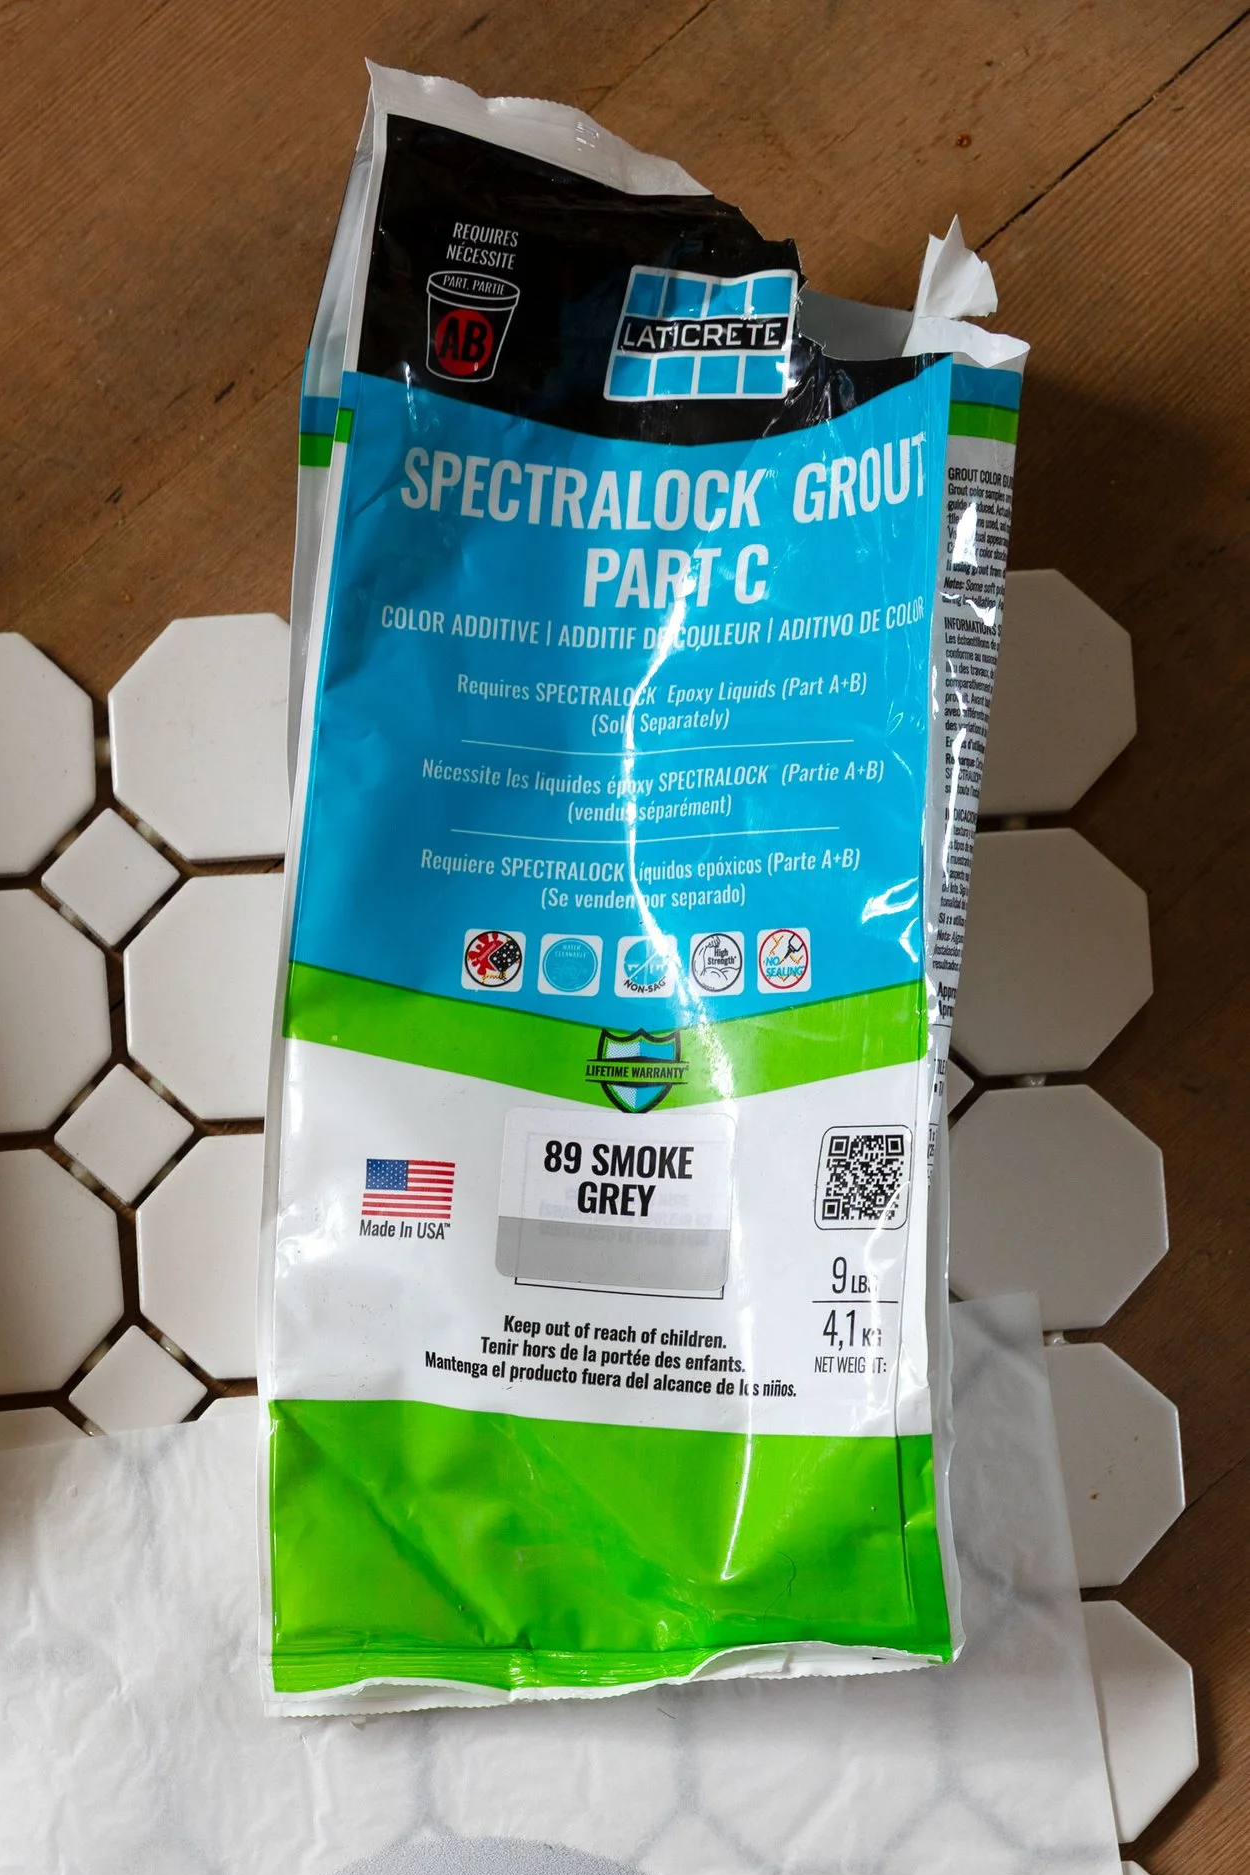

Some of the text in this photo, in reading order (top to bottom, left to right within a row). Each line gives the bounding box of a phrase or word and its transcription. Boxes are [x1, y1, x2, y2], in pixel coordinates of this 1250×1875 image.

[453, 222, 519, 247] REQUIRES
[446, 242, 516, 270] NÉCESSITE
[472, 280, 506, 296] PARTIE
[439, 317, 487, 363] AB
[623, 322, 782, 349] LATICRETE
[792, 431, 926, 524] GROUT
[948, 468, 1001, 486] GROUT COLOR
[948, 483, 1005, 502] Grout color samples
[948, 501, 967, 512] guide
[583, 543, 770, 609] PART C
[944, 577, 982, 593] Notes: Some
[381, 596, 925, 649] COLOR ADDITIVE ADDITIF ADITIVO DE COLOR
[945, 617, 996, 636] INFORMATIONS
[945, 633, 956, 645] Les
[946, 649, 973, 662] conforme
[457, 672, 868, 705] Requires Epoxy Liquids (Part A+B)
[640, 708, 730, 734] Separately)
[945, 708, 960, 717] avec
[422, 759, 885, 797] Nécessite les liquides (Partie A+B)
[638, 794, 732, 822] séparément)
[421, 848, 862, 882] Requiere SPECTRALOCK epóxicos (Parte A+B)
[671, 883, 746, 908] separado)
[714, 948, 728, 958] High
[766, 956, 780, 966] NO
[766, 966, 804, 977] SEALING
[624, 977, 666, 994] NON-SAG
[585, 1065, 629, 1077] LIFETIME
[544, 1140, 694, 1179] 89 SMOKE
[578, 1181, 656, 1217] GREY
[359, 1219, 396, 1238] Made
[832, 1256, 847, 1294] 9
[504, 1314, 727, 1349] Keep out of reach of children.
[480, 1336, 746, 1374] Tenir hors de la portée des enfants.
[814, 1357, 834, 1373] NET
[425, 1351, 797, 1397] Mantenga el producto fuera del alcance de niños.
